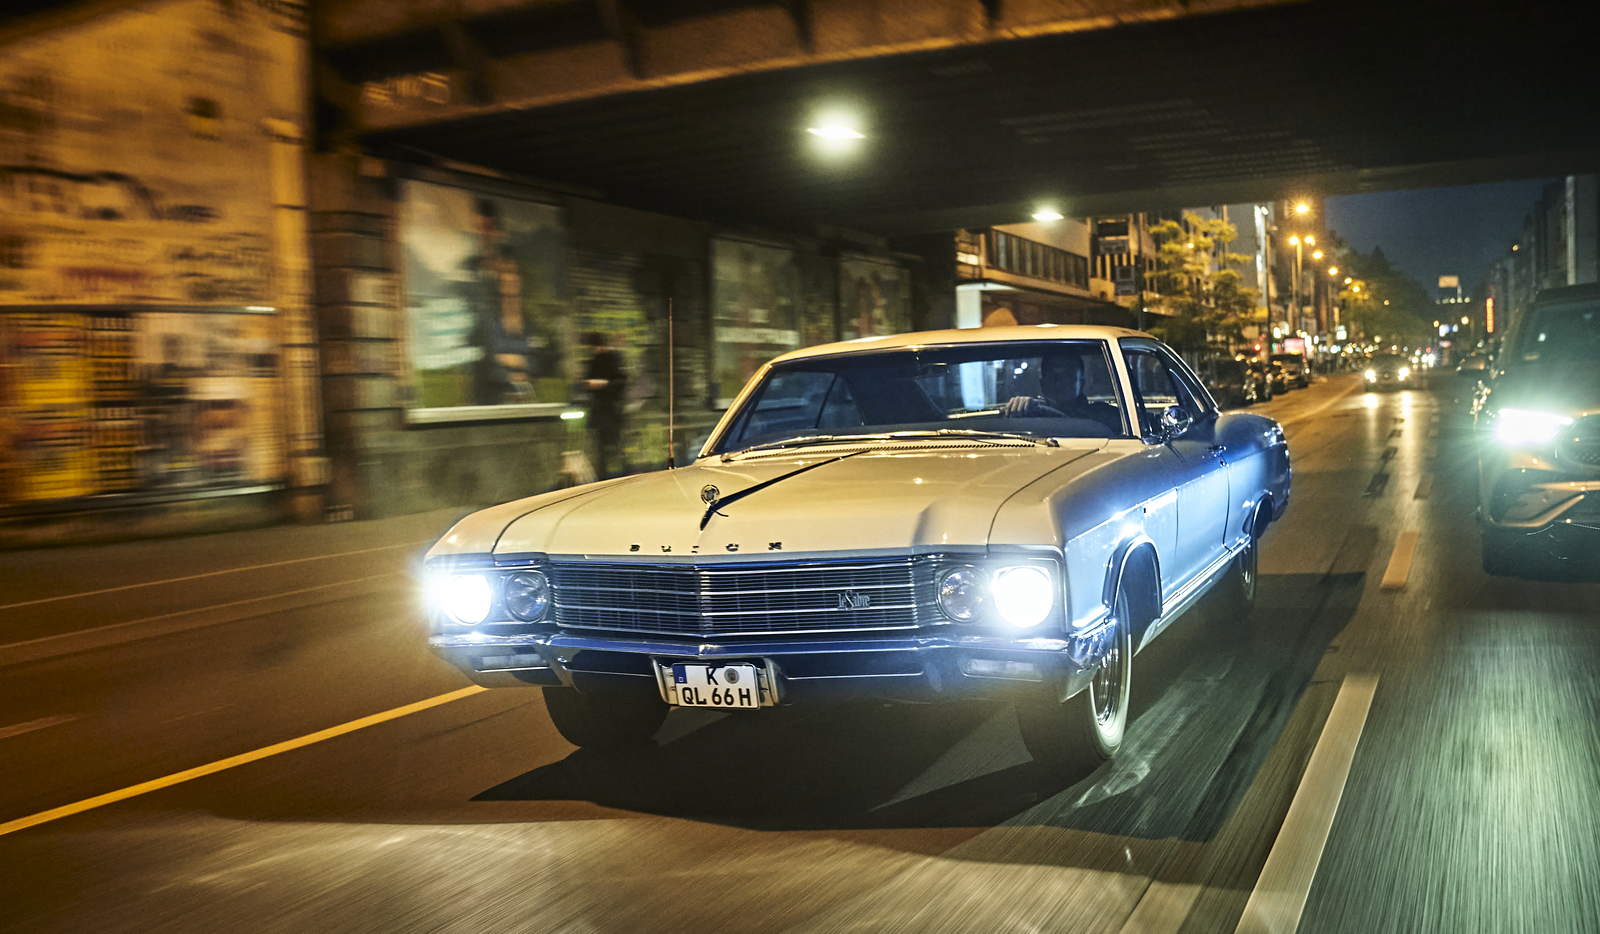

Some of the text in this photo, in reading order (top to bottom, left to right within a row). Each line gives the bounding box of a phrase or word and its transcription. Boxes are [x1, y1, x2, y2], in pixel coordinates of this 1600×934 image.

[630, 542, 782, 553] BUICK
[706, 667, 719, 685] K
[682, 687, 707, 705] QL
